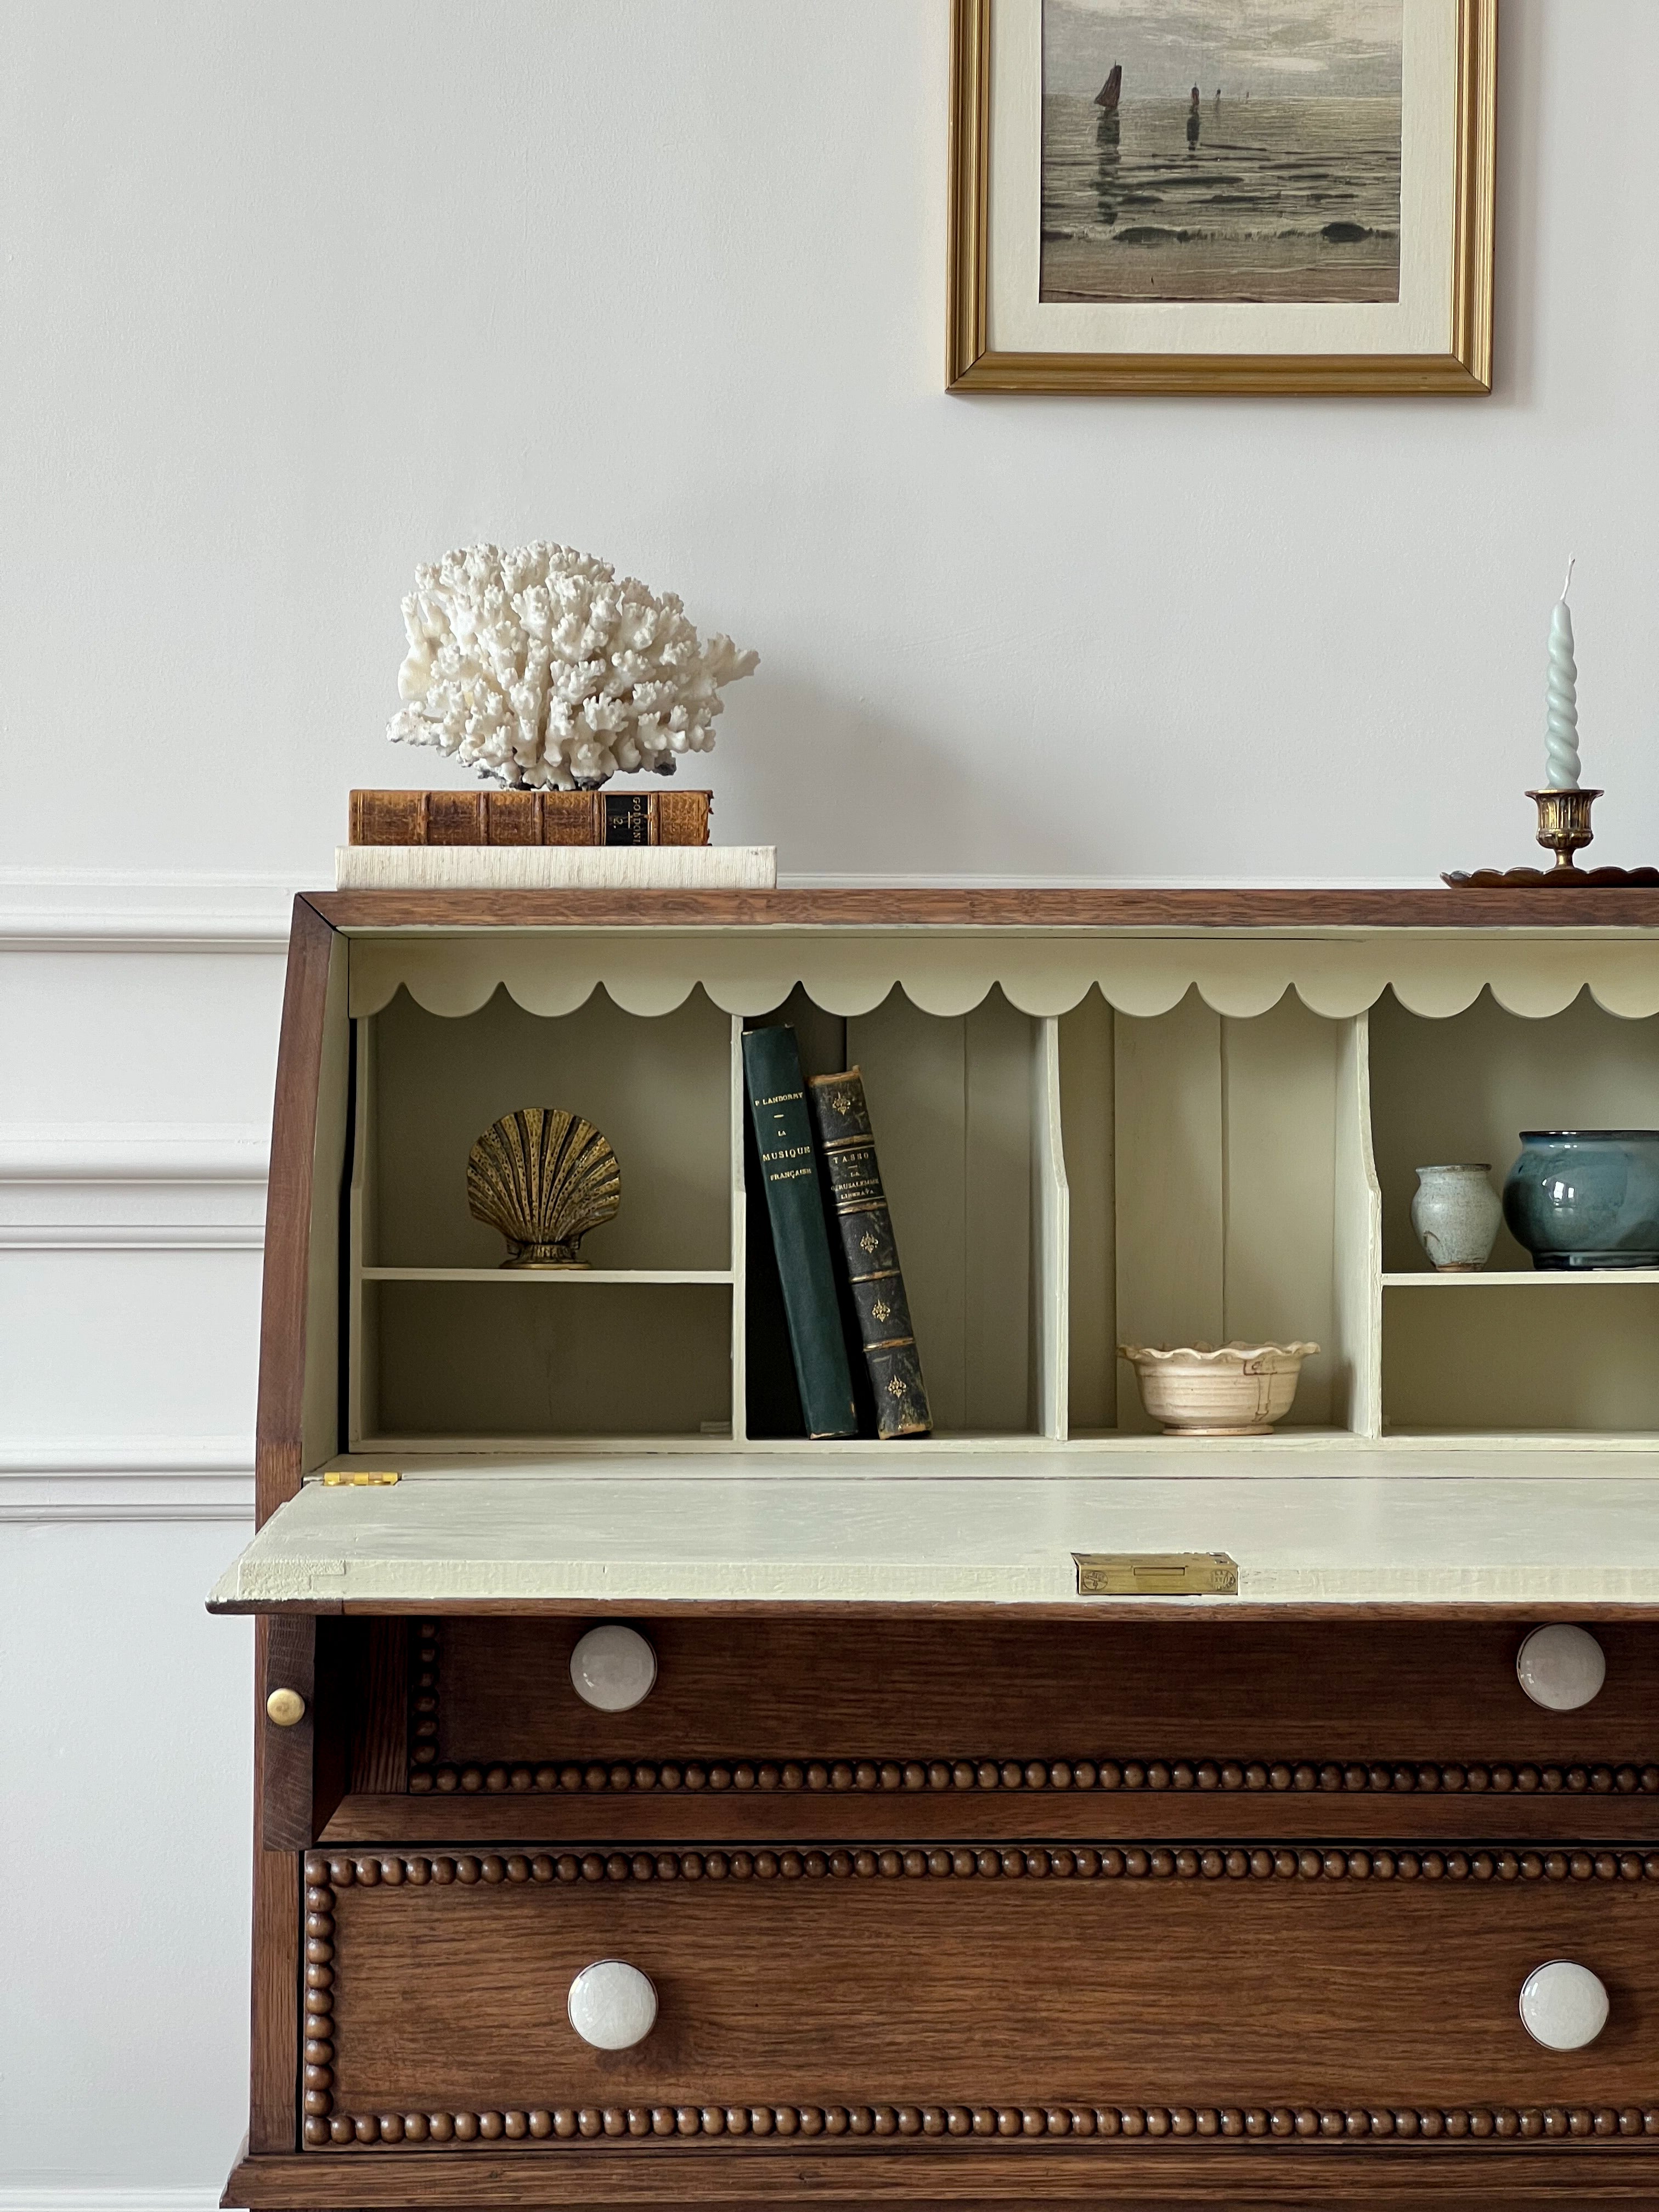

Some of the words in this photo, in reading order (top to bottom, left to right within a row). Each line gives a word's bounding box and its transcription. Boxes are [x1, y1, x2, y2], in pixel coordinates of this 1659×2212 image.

[763, 1092, 803, 1105] LANDORMY
[762, 1146, 811, 1162] MUSIQUE
[833, 1152, 869, 1164] TASSO
[770, 1168, 812, 1181] FRANÇAISE
